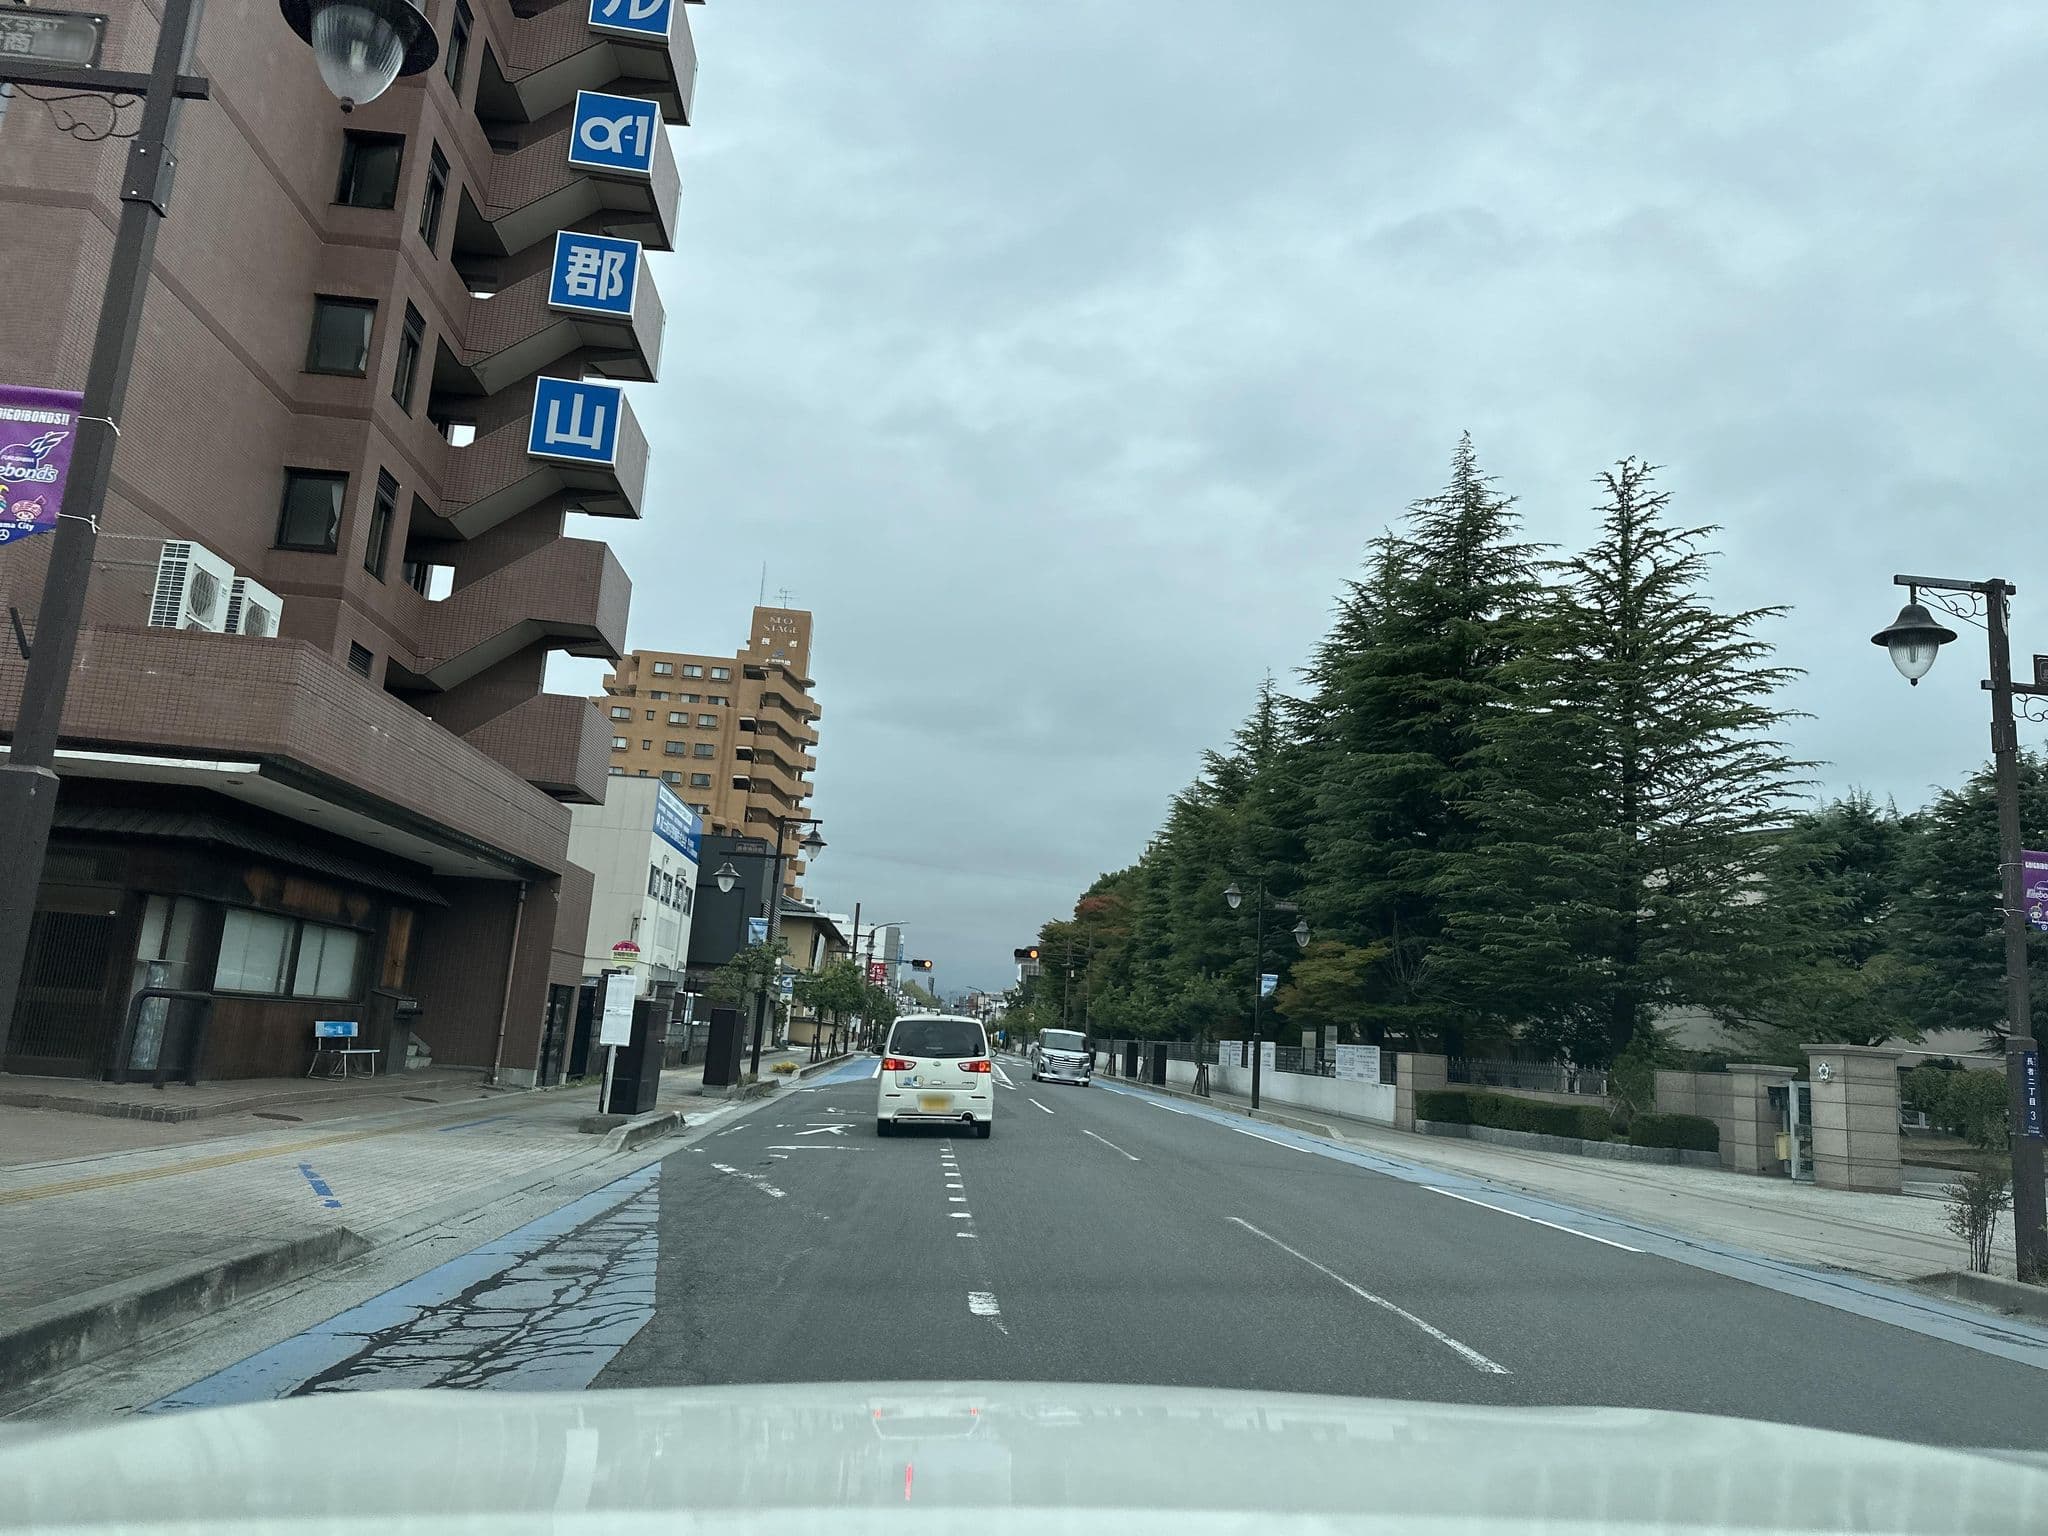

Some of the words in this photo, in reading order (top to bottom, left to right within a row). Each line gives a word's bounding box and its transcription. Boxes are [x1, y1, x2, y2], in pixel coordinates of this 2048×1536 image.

[17, 522, 35, 532] City
[769, 616, 793, 625] NEO
[763, 625, 799, 634] STAGE
